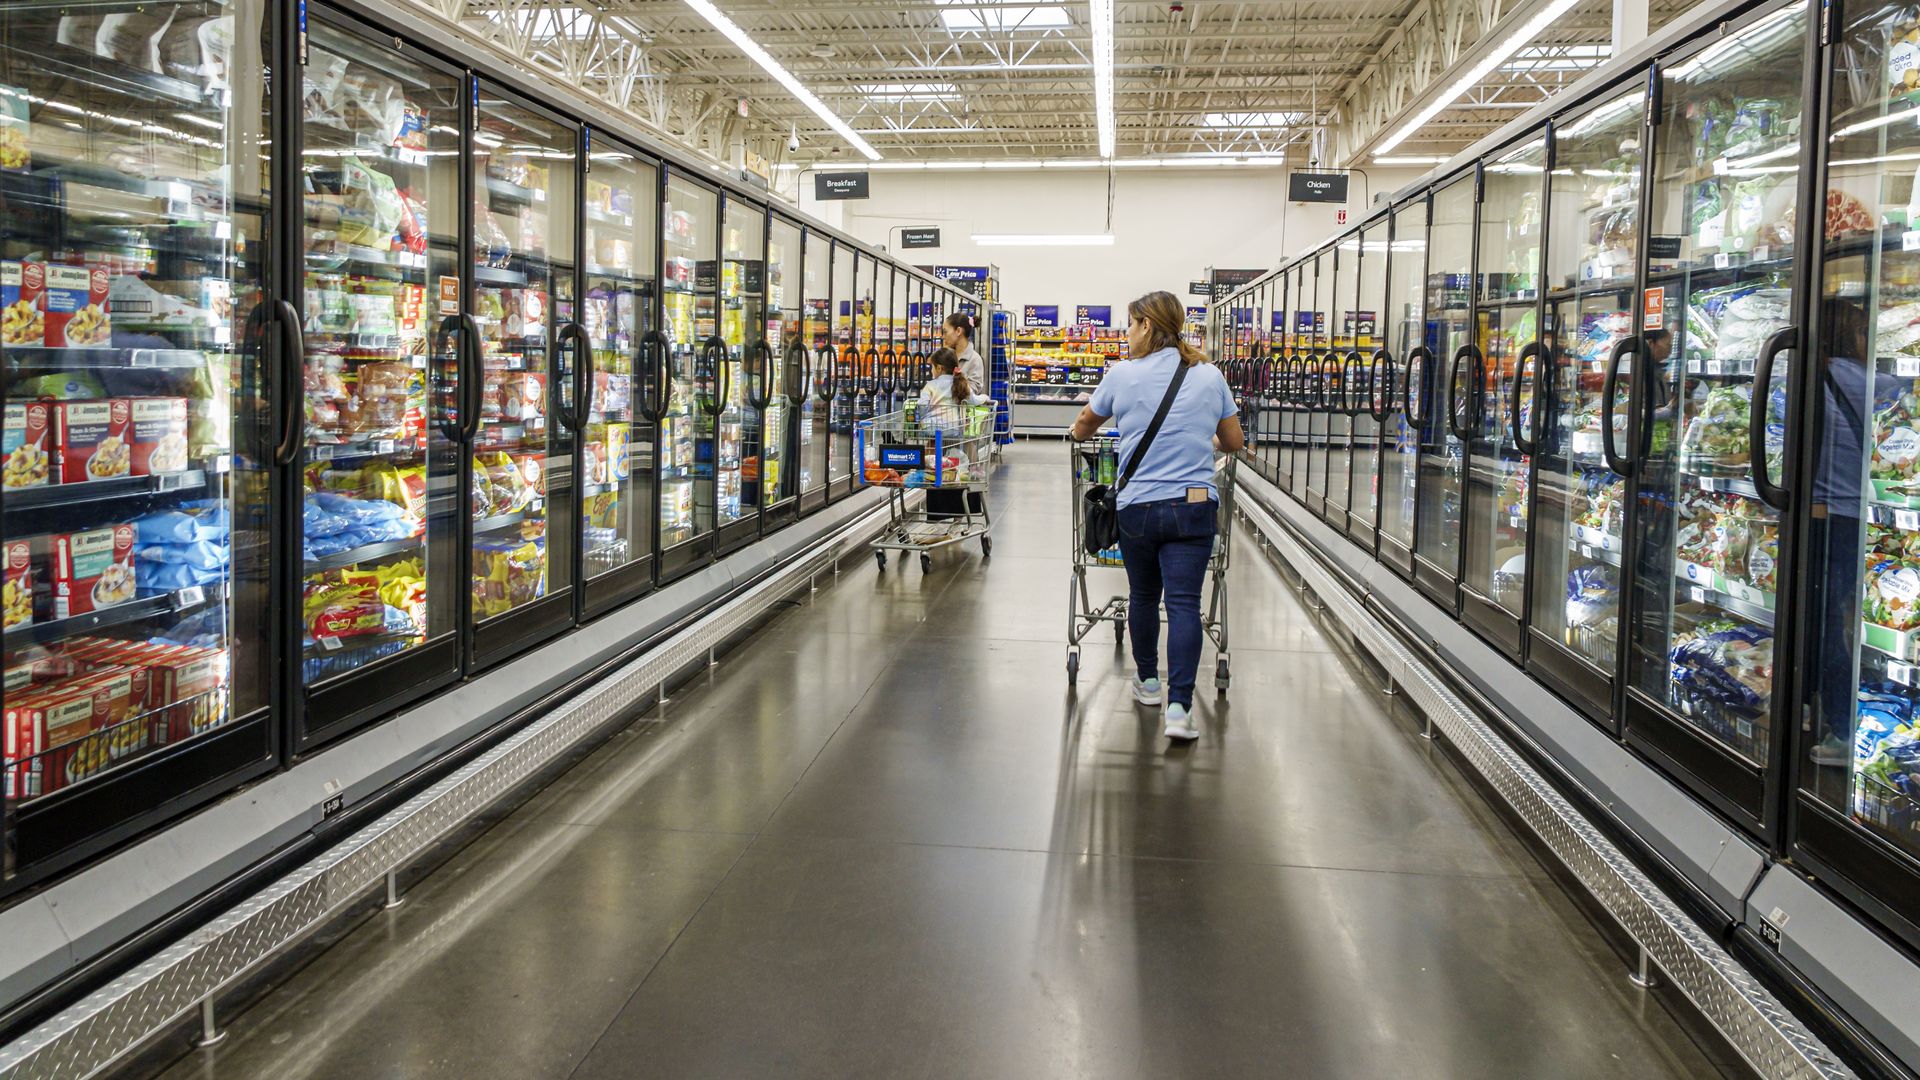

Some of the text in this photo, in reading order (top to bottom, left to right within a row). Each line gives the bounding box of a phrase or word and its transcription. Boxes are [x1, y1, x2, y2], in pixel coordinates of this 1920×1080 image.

[959, 271, 977, 279] Price
[444, 285, 457, 296] WIC
[1649, 296, 1661, 307] WIC
